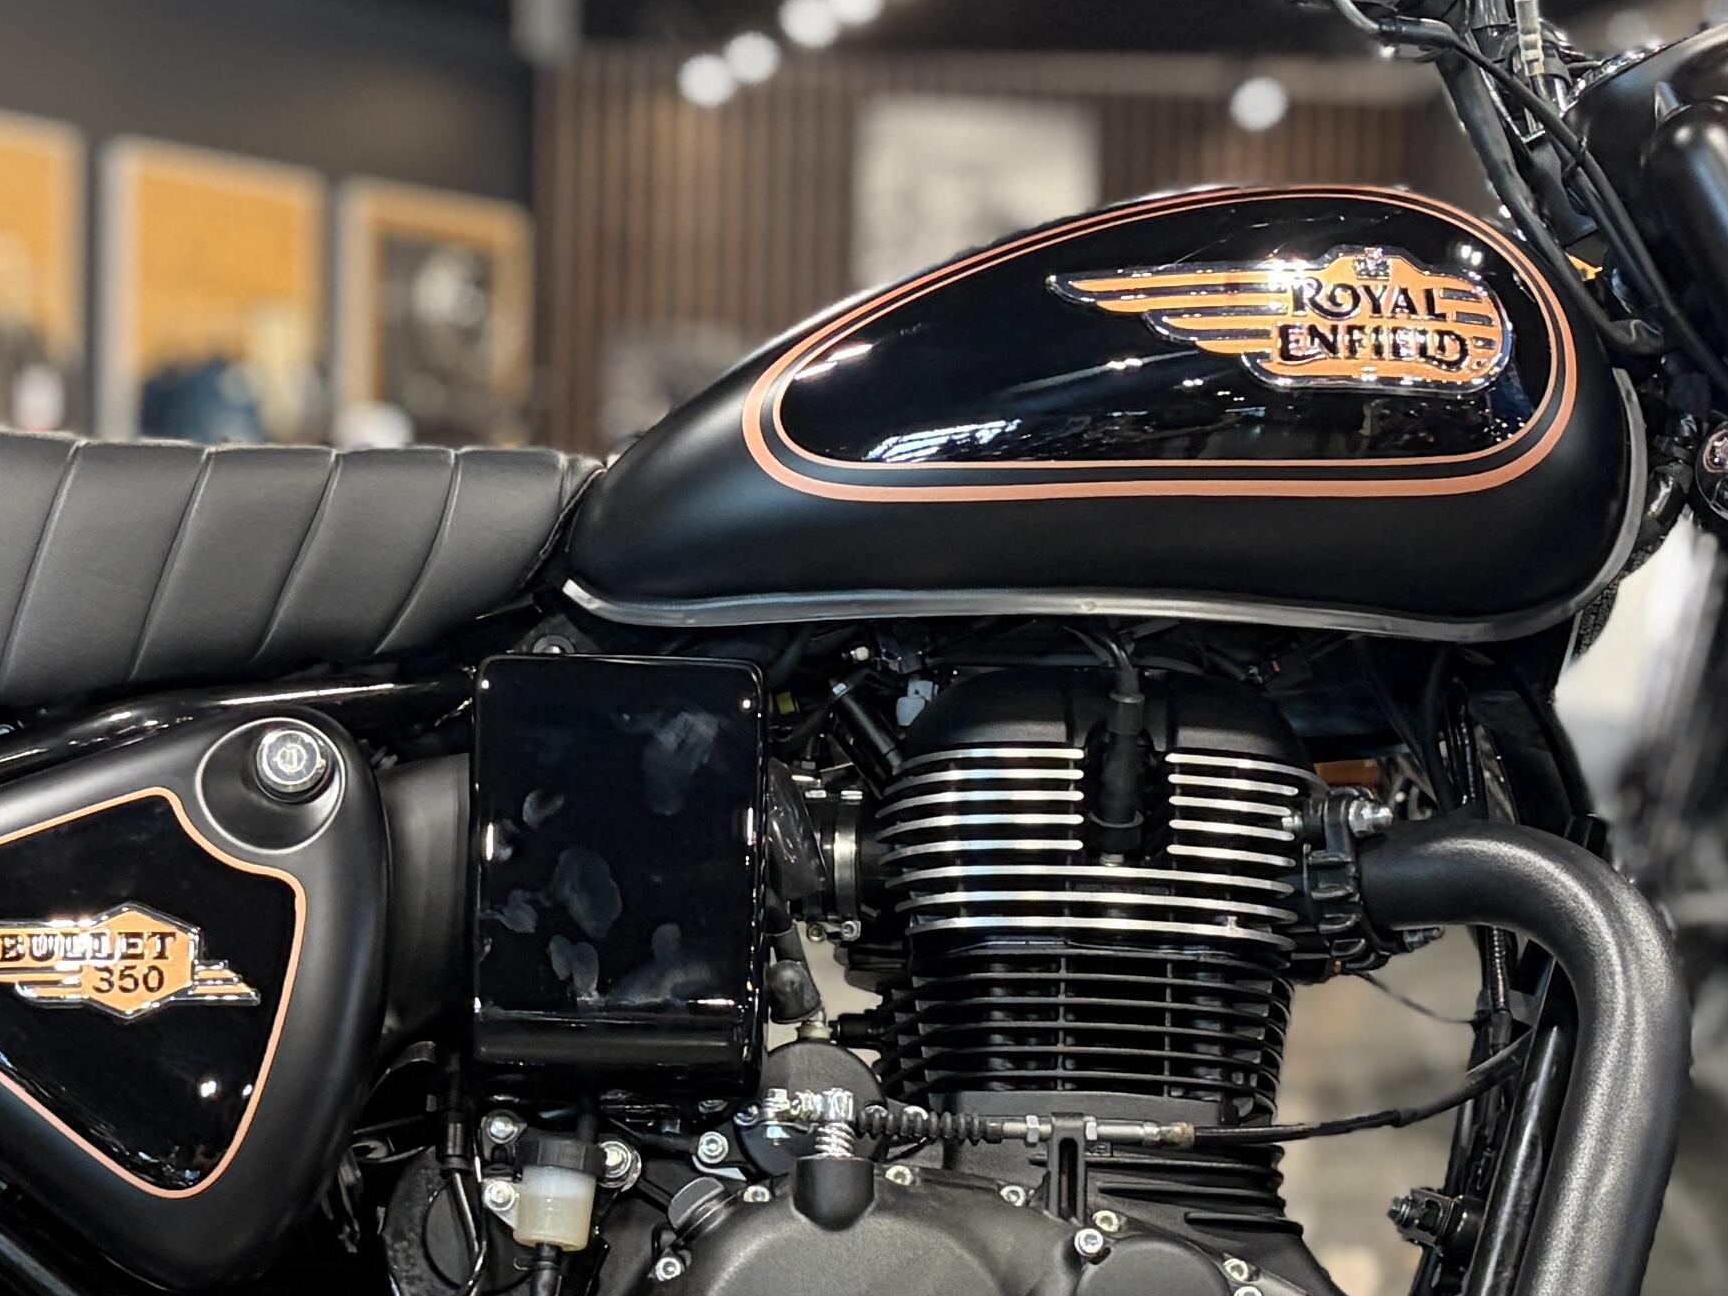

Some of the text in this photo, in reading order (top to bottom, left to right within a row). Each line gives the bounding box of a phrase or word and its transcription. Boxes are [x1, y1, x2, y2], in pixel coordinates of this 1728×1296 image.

[1291, 276, 1448, 321] ROYAL
[1277, 323, 1471, 372] ENFIELD
[91, 964, 165, 994] 350
